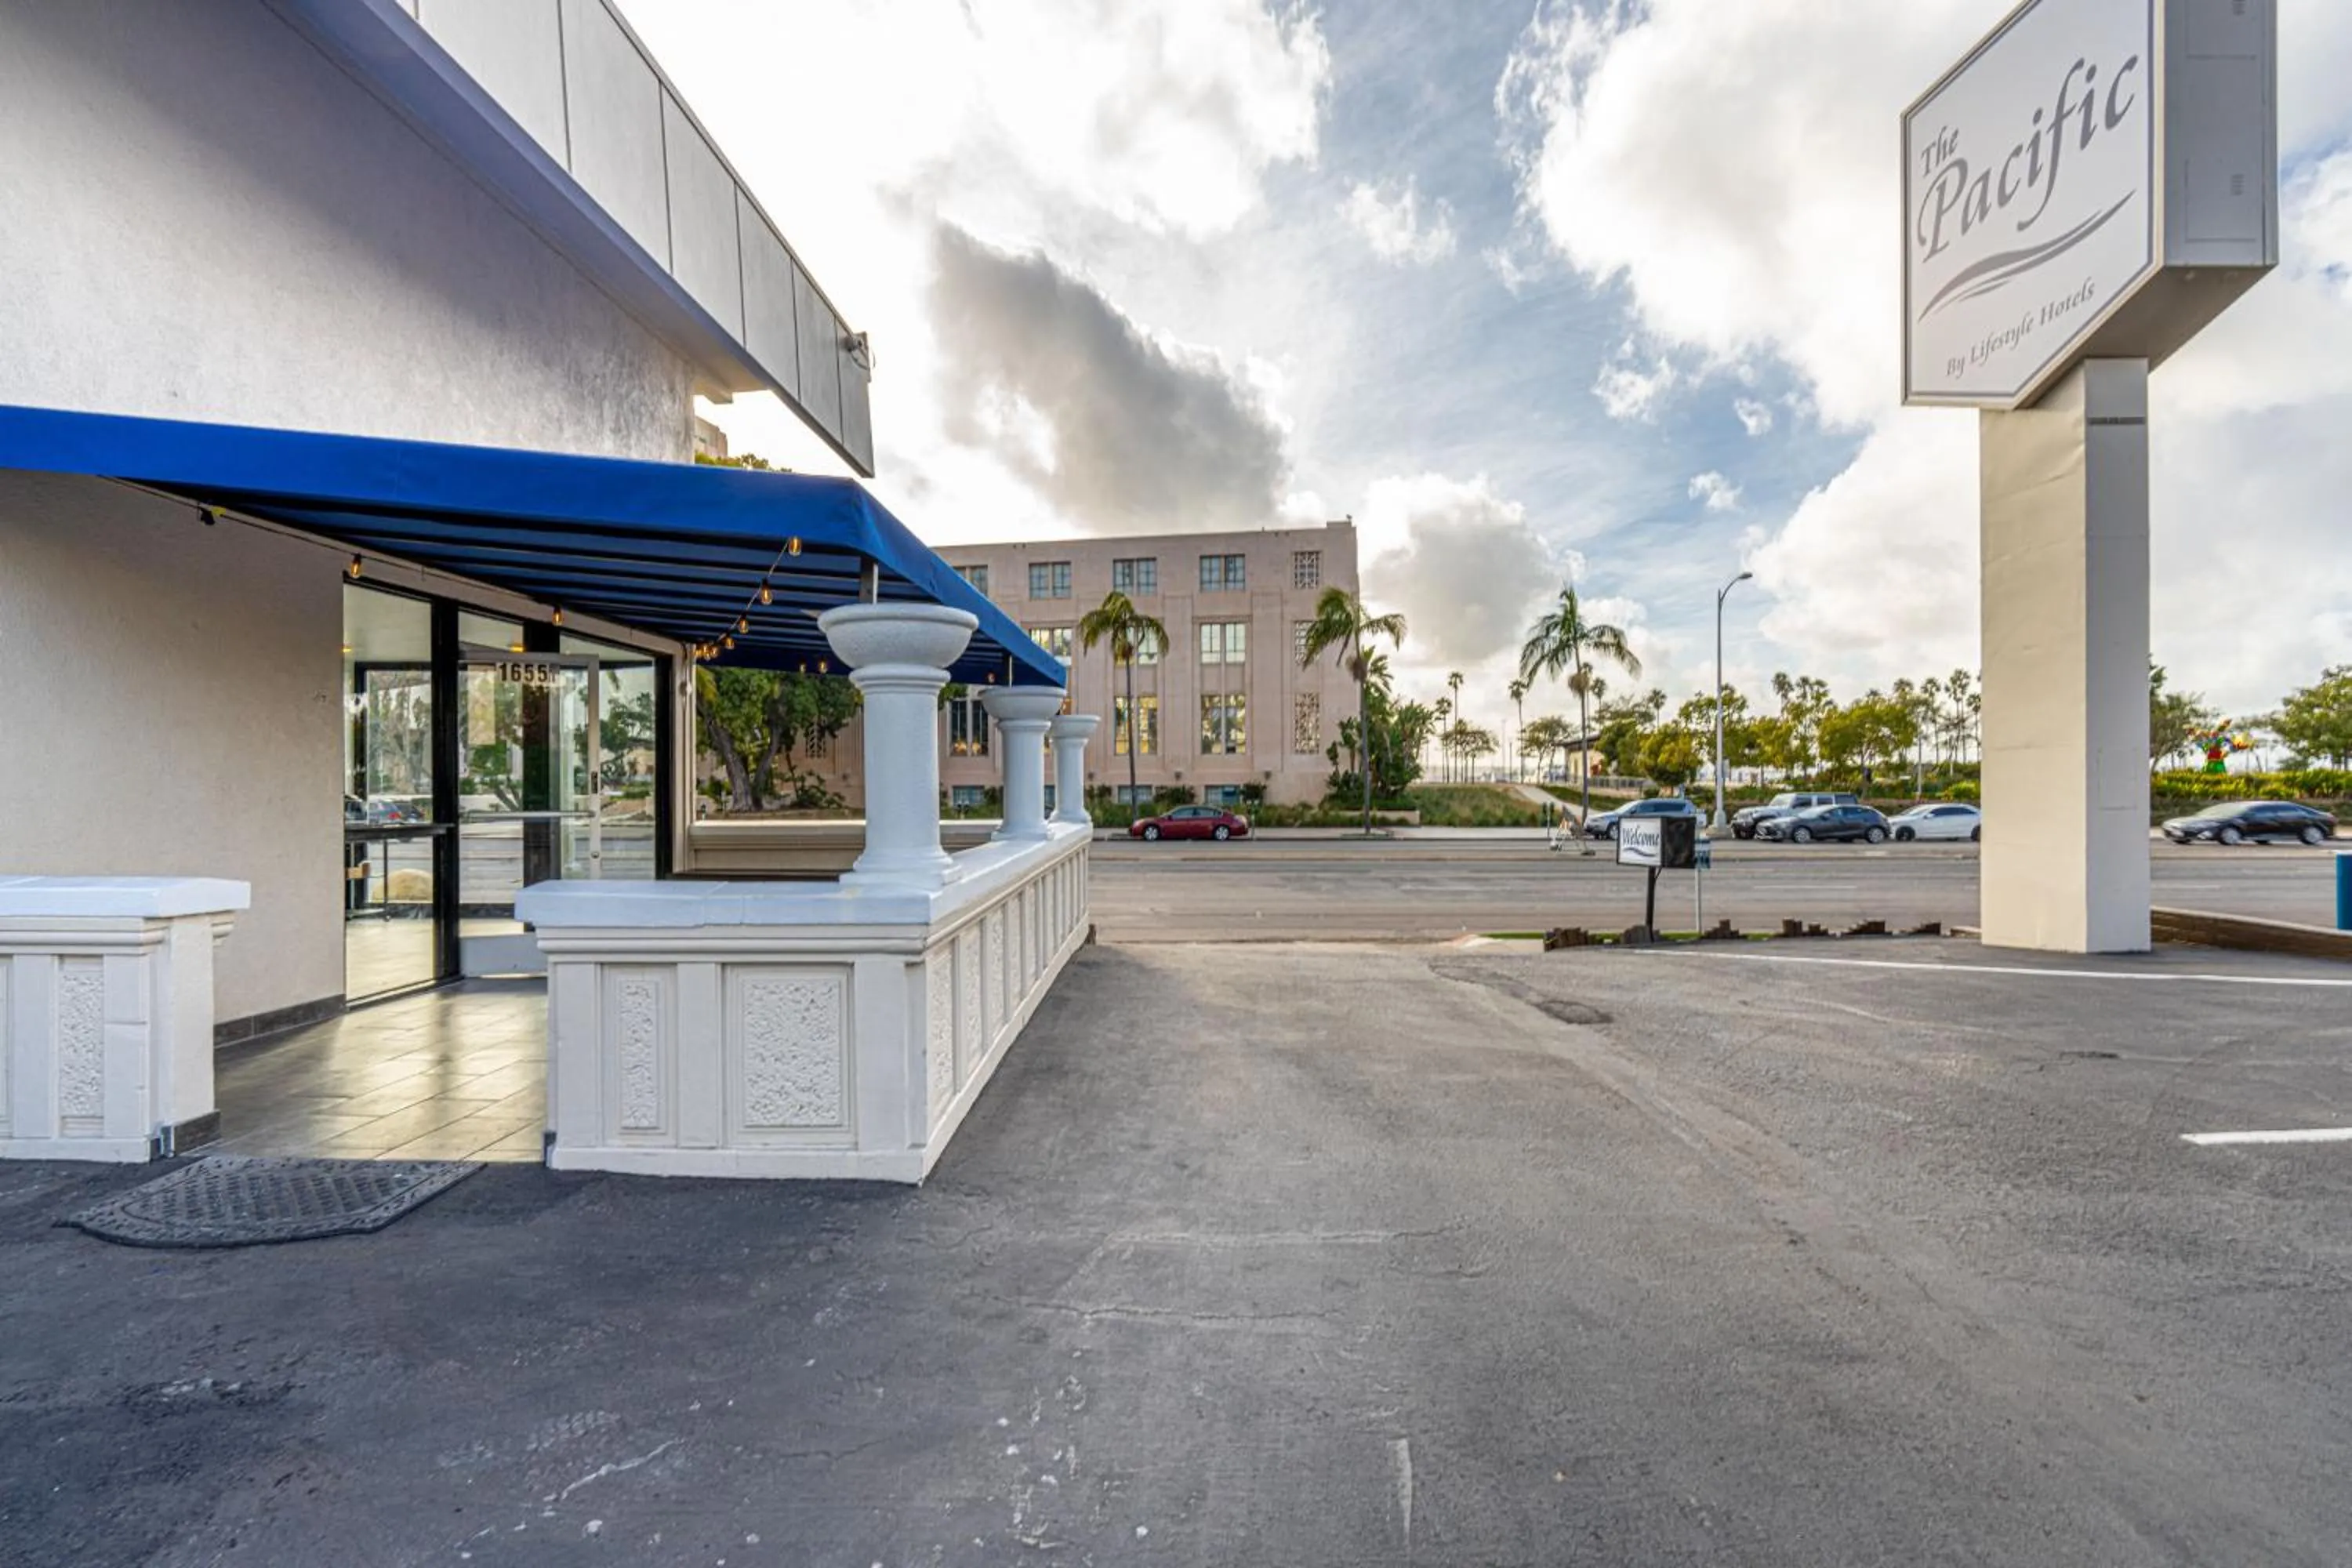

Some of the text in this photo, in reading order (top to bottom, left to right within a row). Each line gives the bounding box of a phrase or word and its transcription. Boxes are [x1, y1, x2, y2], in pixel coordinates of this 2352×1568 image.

[1918, 55, 2138, 263] Pacific
[1922, 125, 1958, 178] The
[1947, 276, 2095, 379] By Lifestyle Hotels
[499, 662, 547, 682] 1655
[1622, 826, 1660, 846] Welcome
